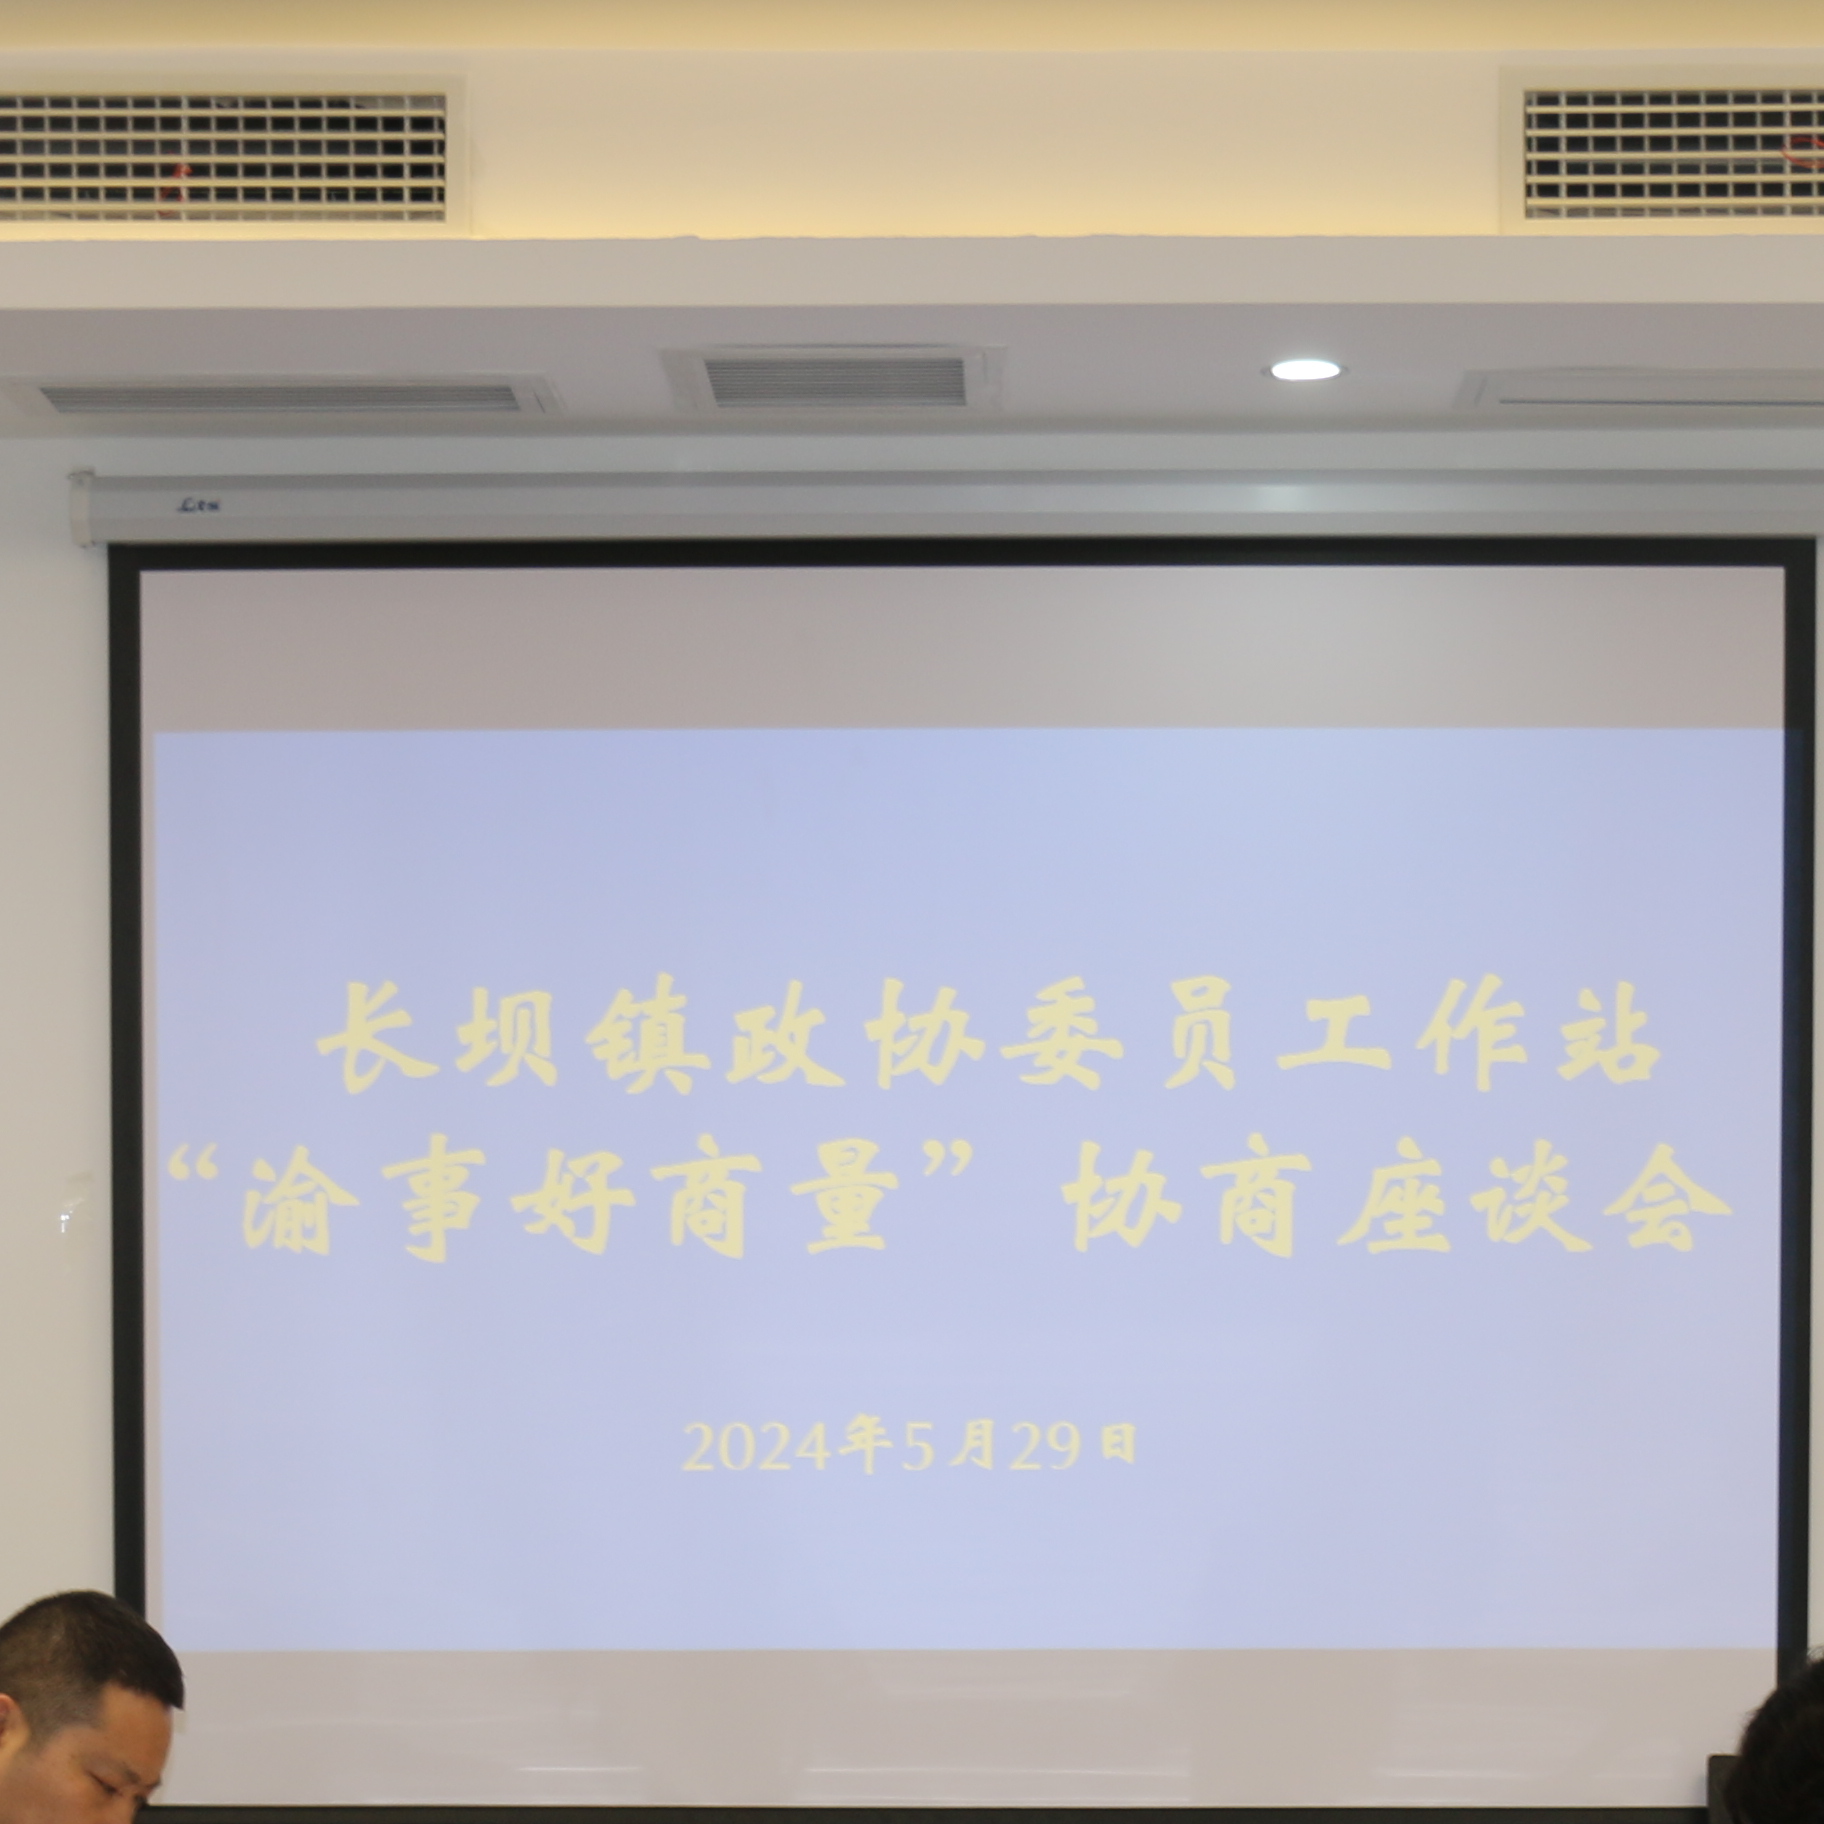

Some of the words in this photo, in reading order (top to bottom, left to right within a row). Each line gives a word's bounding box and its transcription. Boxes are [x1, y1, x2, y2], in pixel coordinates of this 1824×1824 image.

[314, 970, 1663, 1096] 长坝镇政协委员工作站
[681, 1412, 1138, 1475] 2024年5月29日
